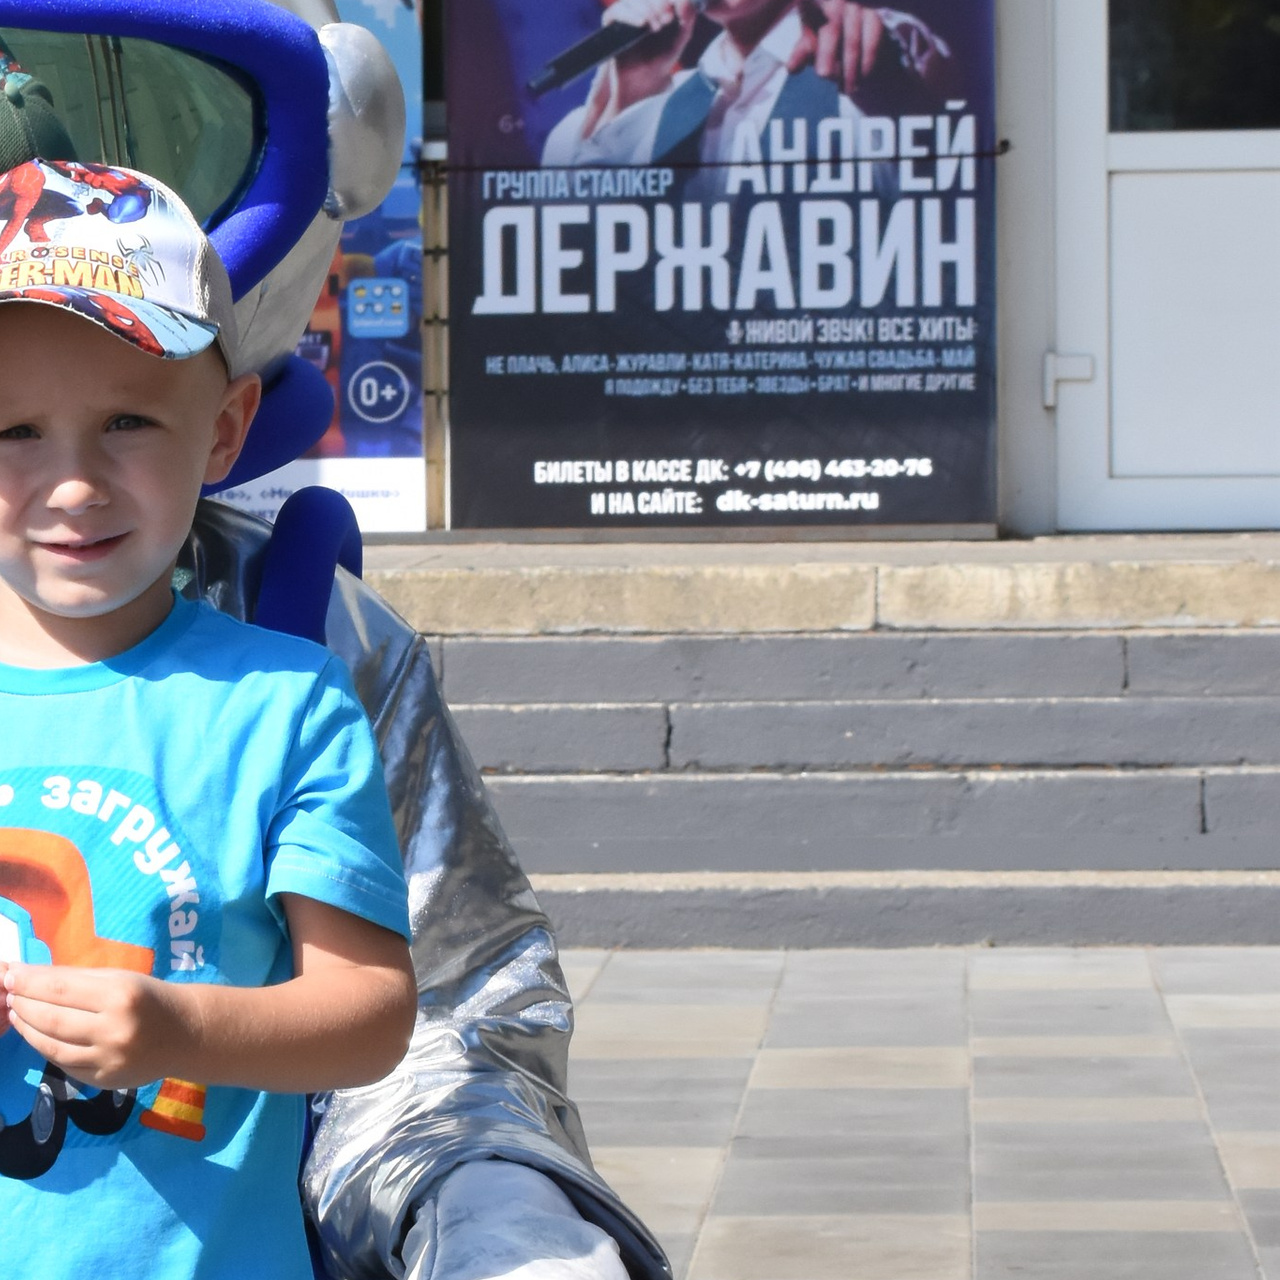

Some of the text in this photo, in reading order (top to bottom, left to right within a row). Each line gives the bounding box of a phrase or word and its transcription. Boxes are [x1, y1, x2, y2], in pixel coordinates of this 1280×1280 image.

[725, 100, 976, 195] АНДРЕЙ
[482, 168, 675, 200] ГРУППА СТАЛКЕР
[471, 197, 977, 315] ДЕРЖАВИН
[745, 314, 814, 344] ЖИВОЙ
[816, 318, 874, 343] ЗВУК!
[877, 318, 914, 342] ВСЕ
[360, 376, 398, 407] 0+
[534, 460, 612, 484] БИЛЕТЫ
[615, 459, 630, 483] В
[632, 458, 692, 483] КАССЕ
[694, 458, 729, 484] ДК:
[734, 460, 761, 479] +7
[764, 459, 821, 483] (496)
[590, 487, 880, 515] И НА САЙТЕ: dk-saturn.ru
[41, 775, 205, 972] загружай
